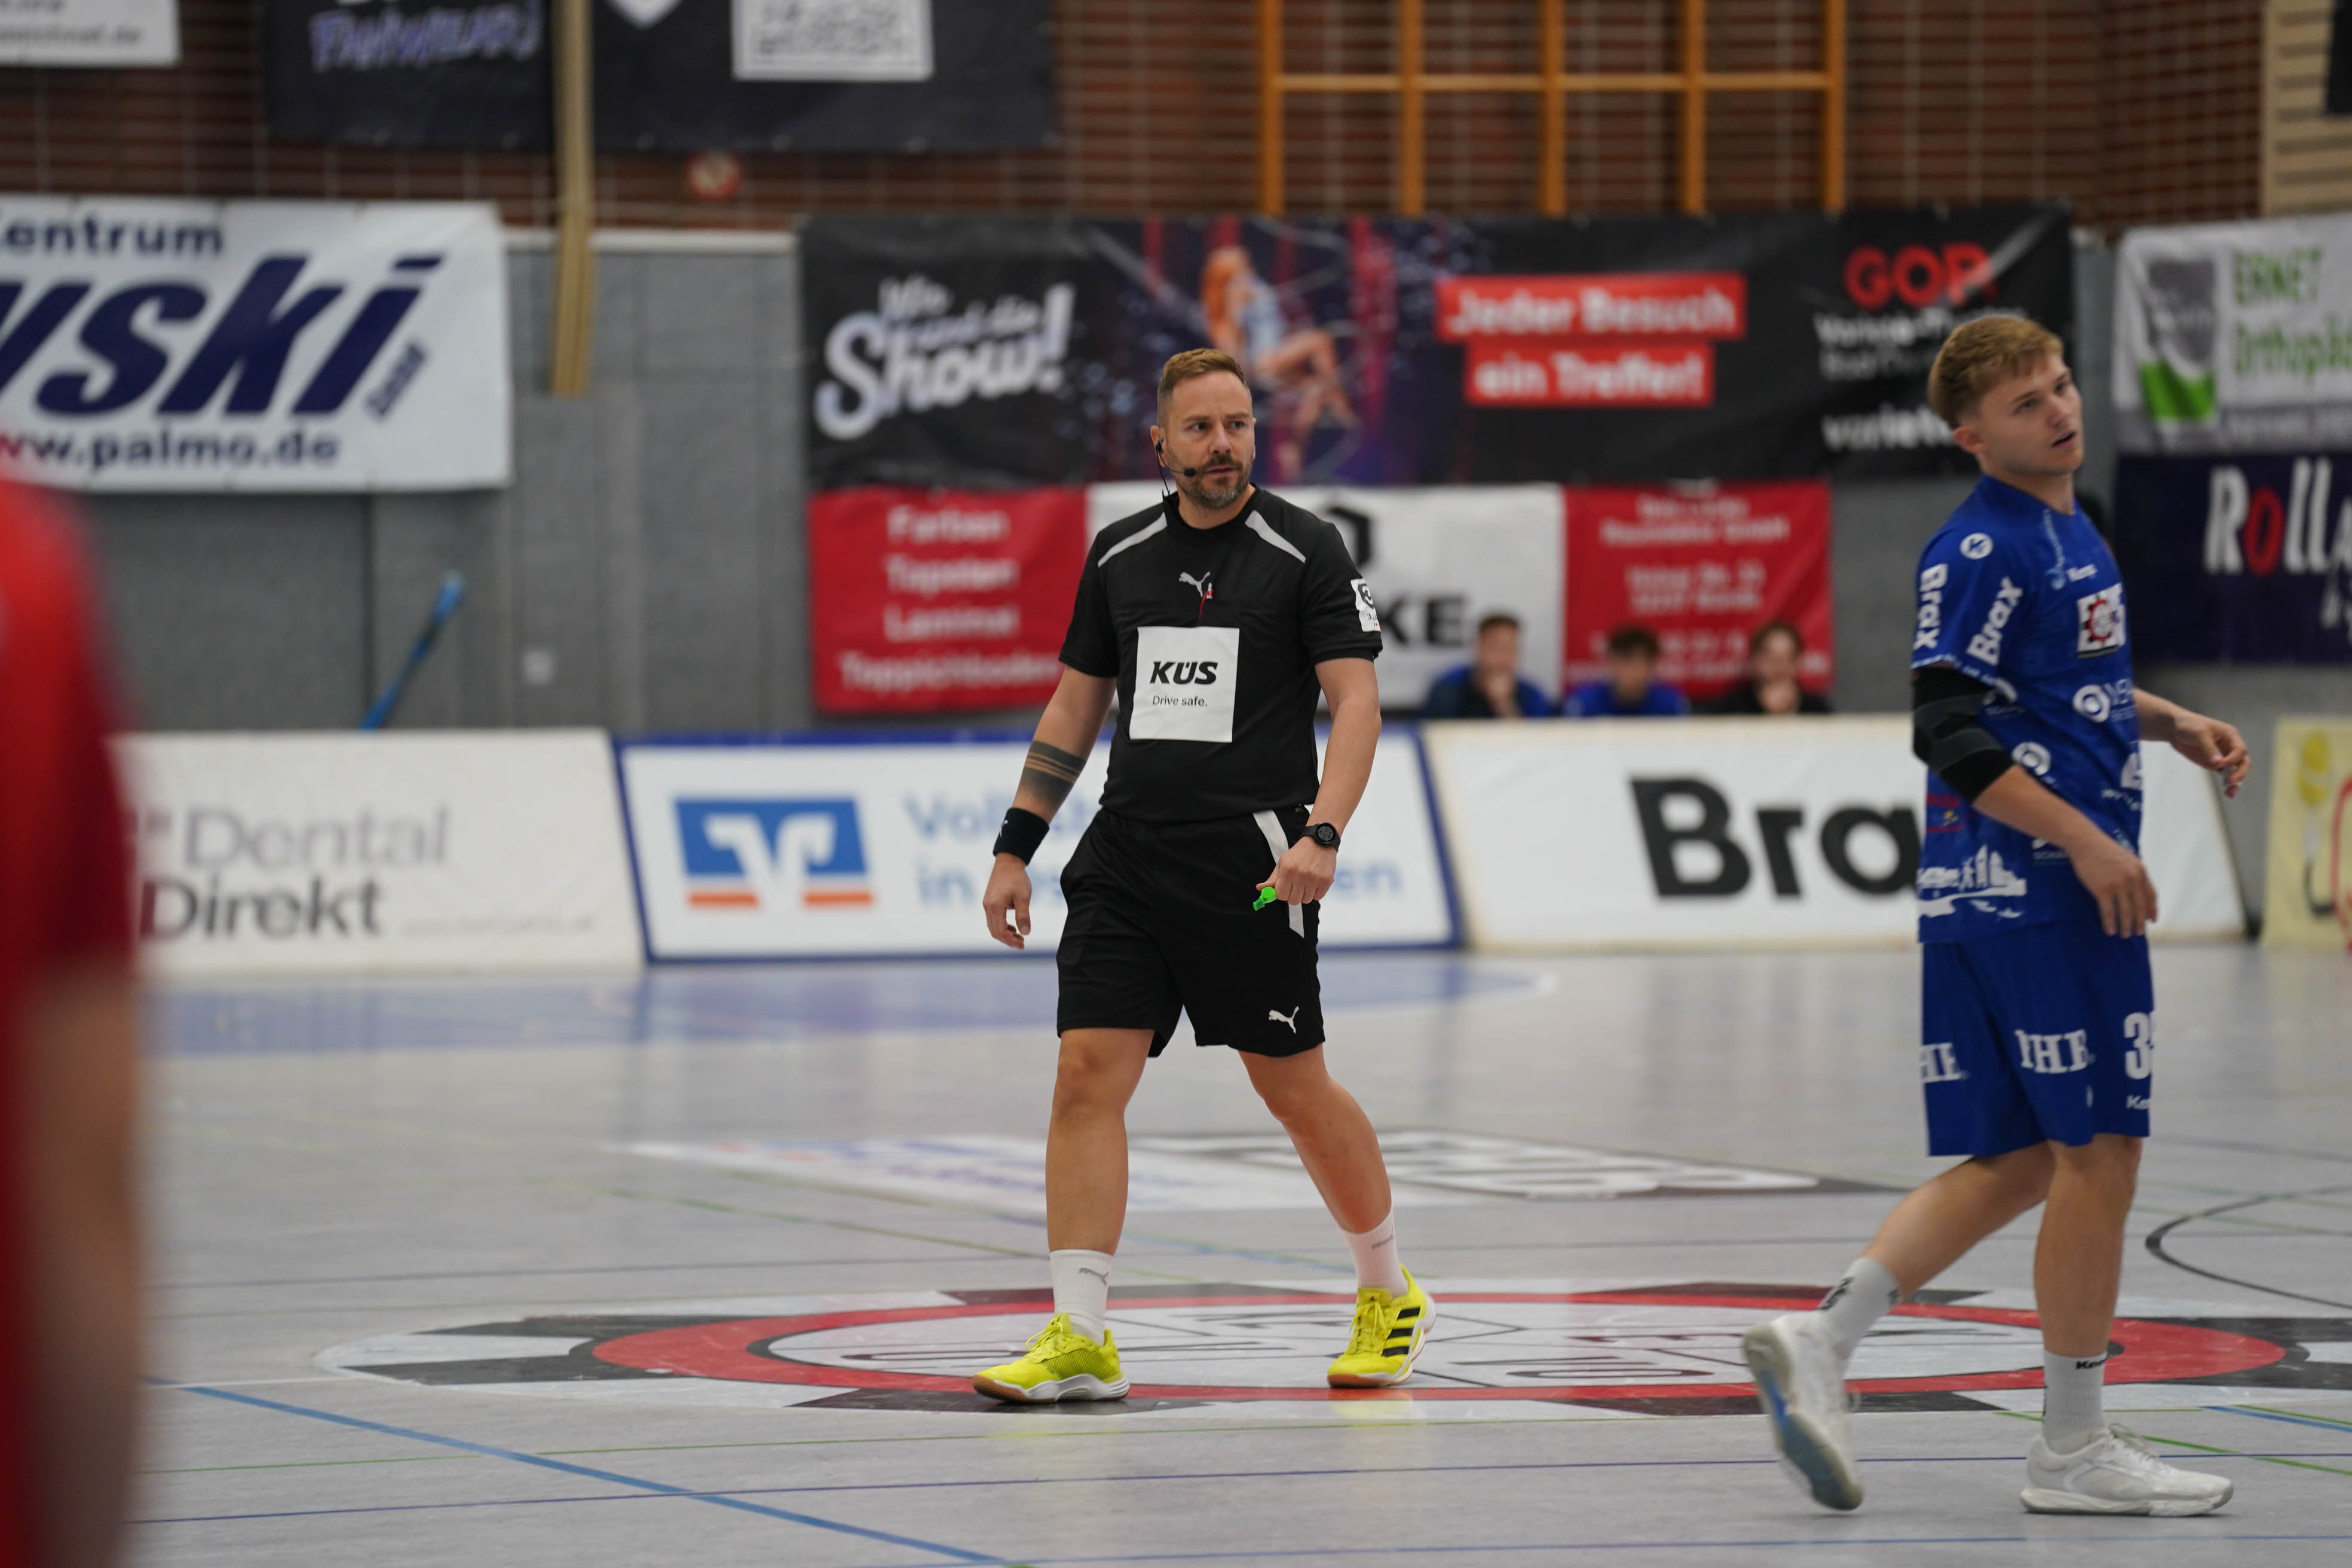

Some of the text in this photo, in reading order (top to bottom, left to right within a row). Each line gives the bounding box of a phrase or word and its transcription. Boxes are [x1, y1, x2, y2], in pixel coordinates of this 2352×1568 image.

[1449, 287, 1736, 335] Jeder Besuch
[814, 283, 1076, 439] Show!
[1473, 351, 1548, 398] ein
[1912, 564, 1949, 651] Brax
[1966, 575, 2024, 666] Brax
[1149, 661, 1218, 685] KÜS
[1152, 695, 1208, 706] Drive safe.
[184, 804, 449, 871] Dental
[1629, 777, 1920, 898] Bra
[139, 875, 384, 940] Direkt
[2124, 1012, 2154, 1080] 3
